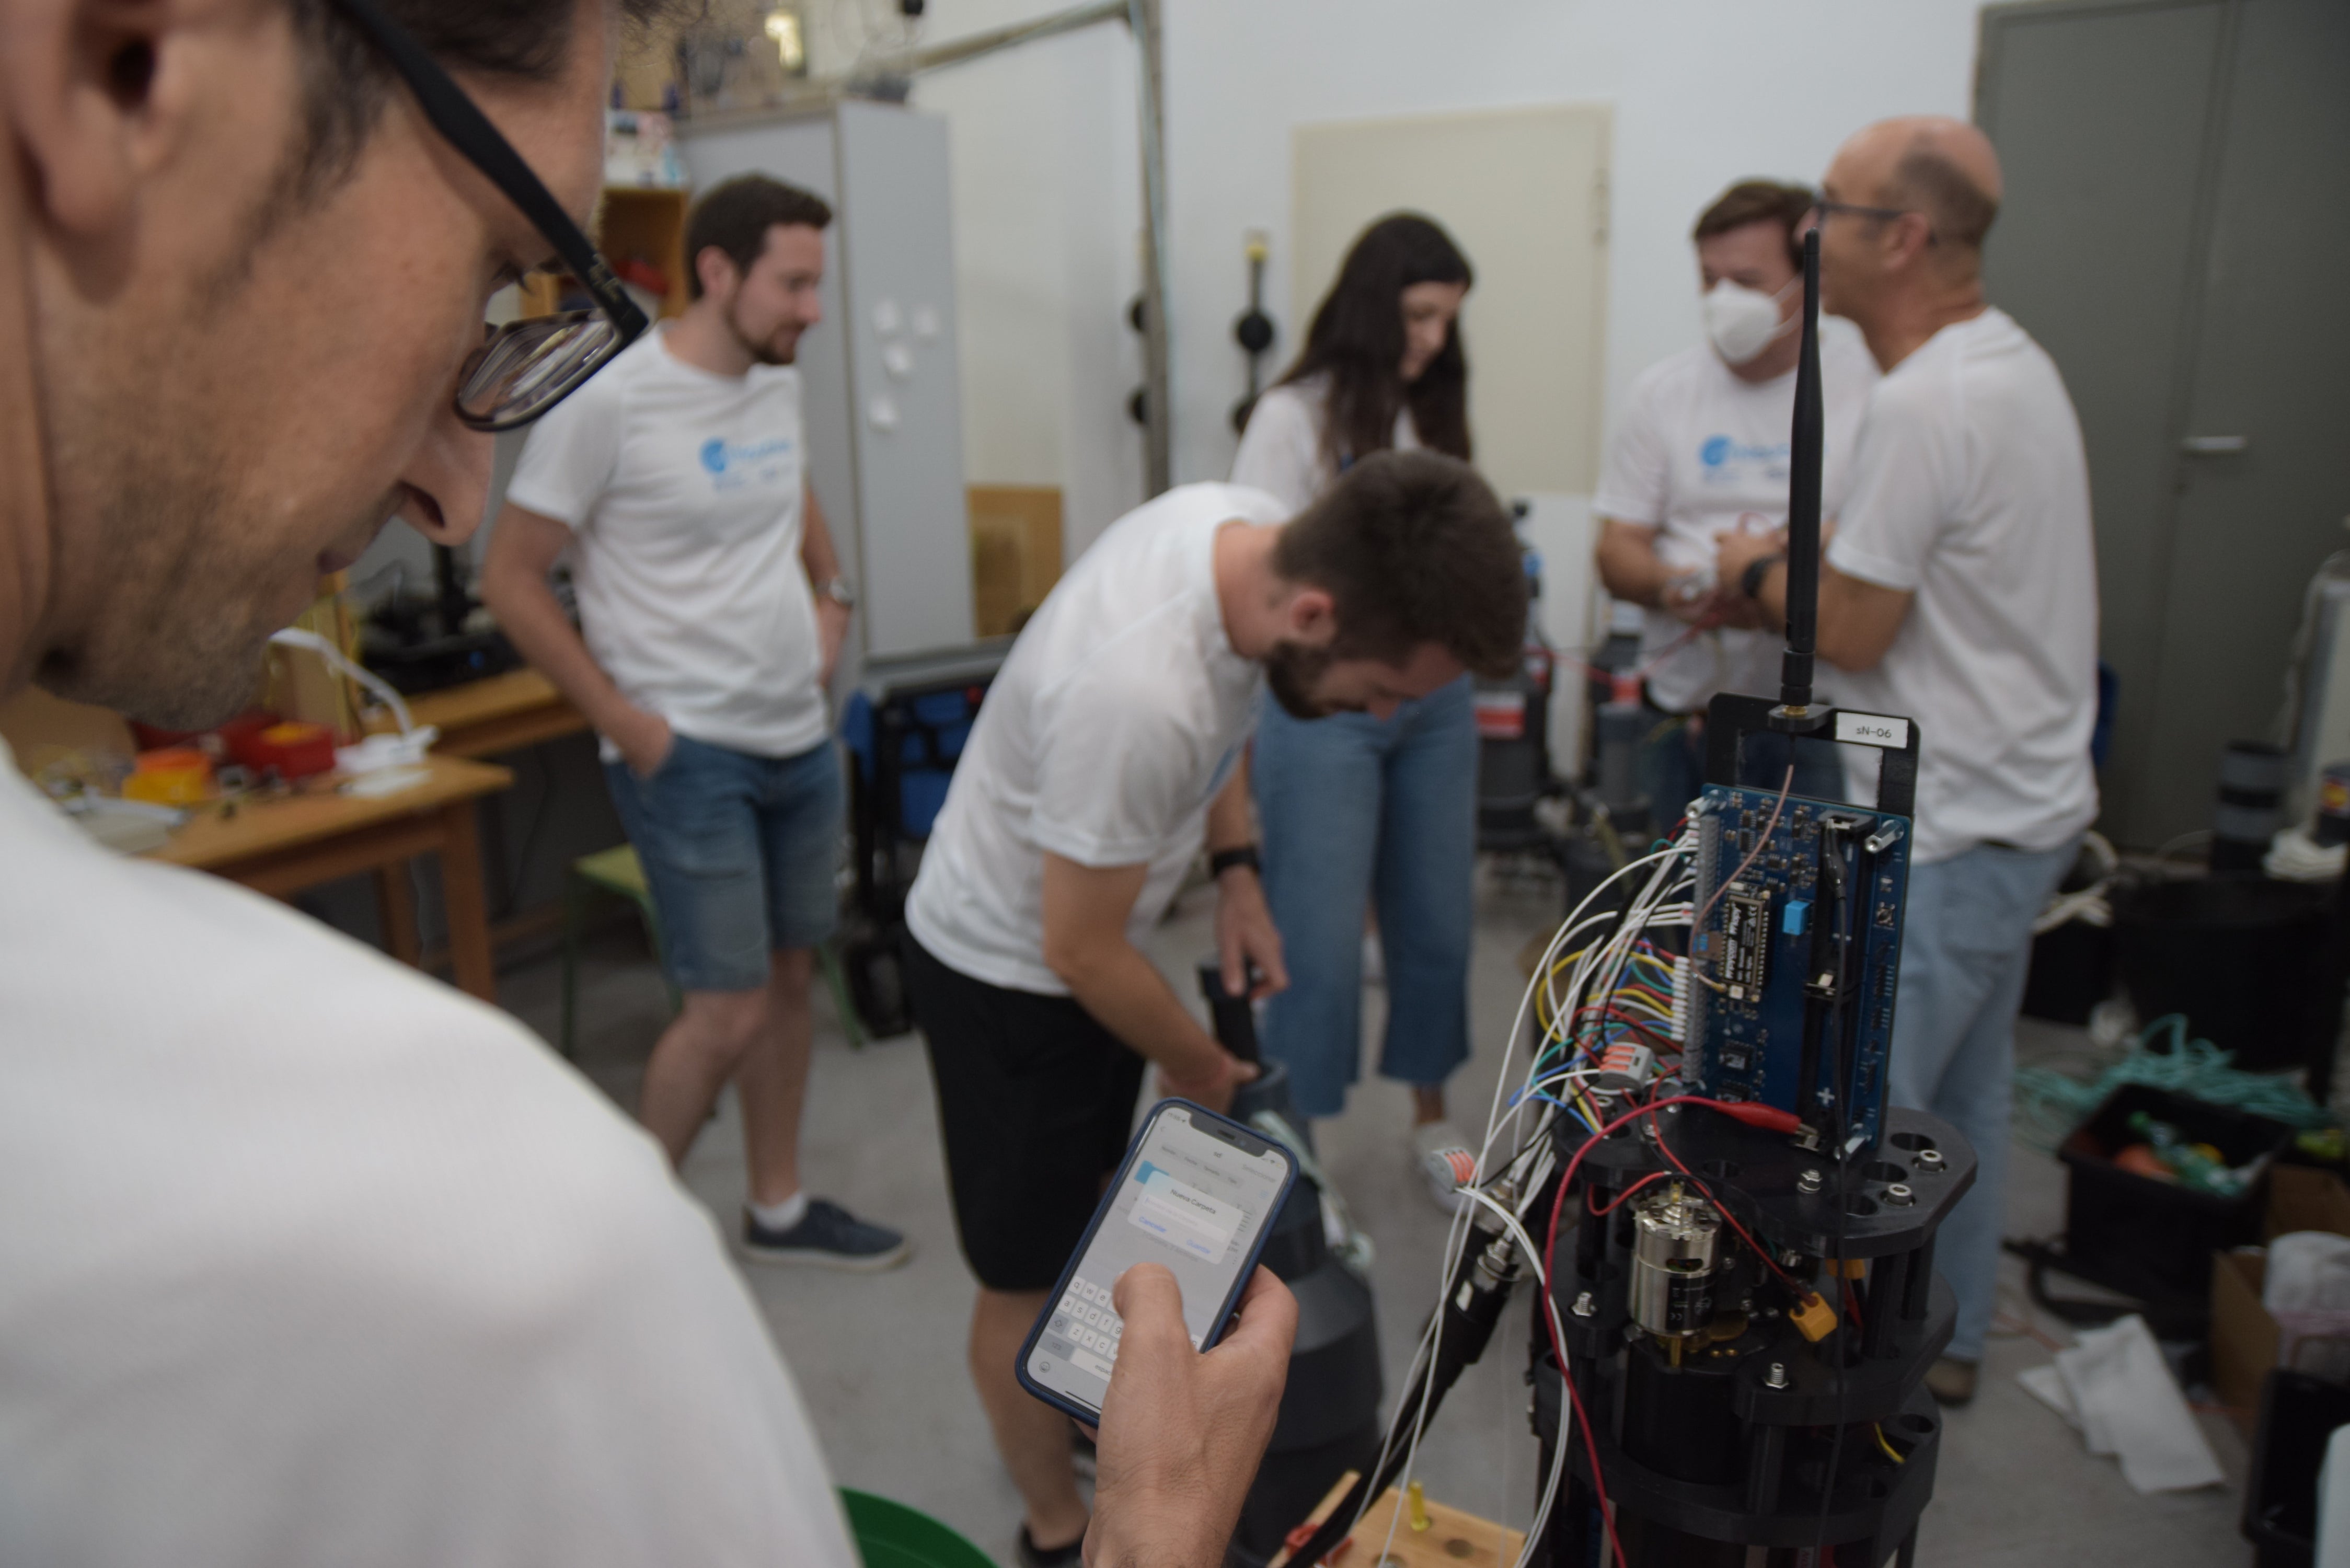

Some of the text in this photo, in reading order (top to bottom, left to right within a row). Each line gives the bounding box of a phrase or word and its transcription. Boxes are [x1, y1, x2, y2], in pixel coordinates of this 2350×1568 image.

[1170, 1189, 1216, 1215] Nueva Carpeta
[1139, 1216, 1166, 1232] Cancelar
[1186, 1239, 1211, 1254] Guardar
[1095, 1365, 1111, 1376] espac
